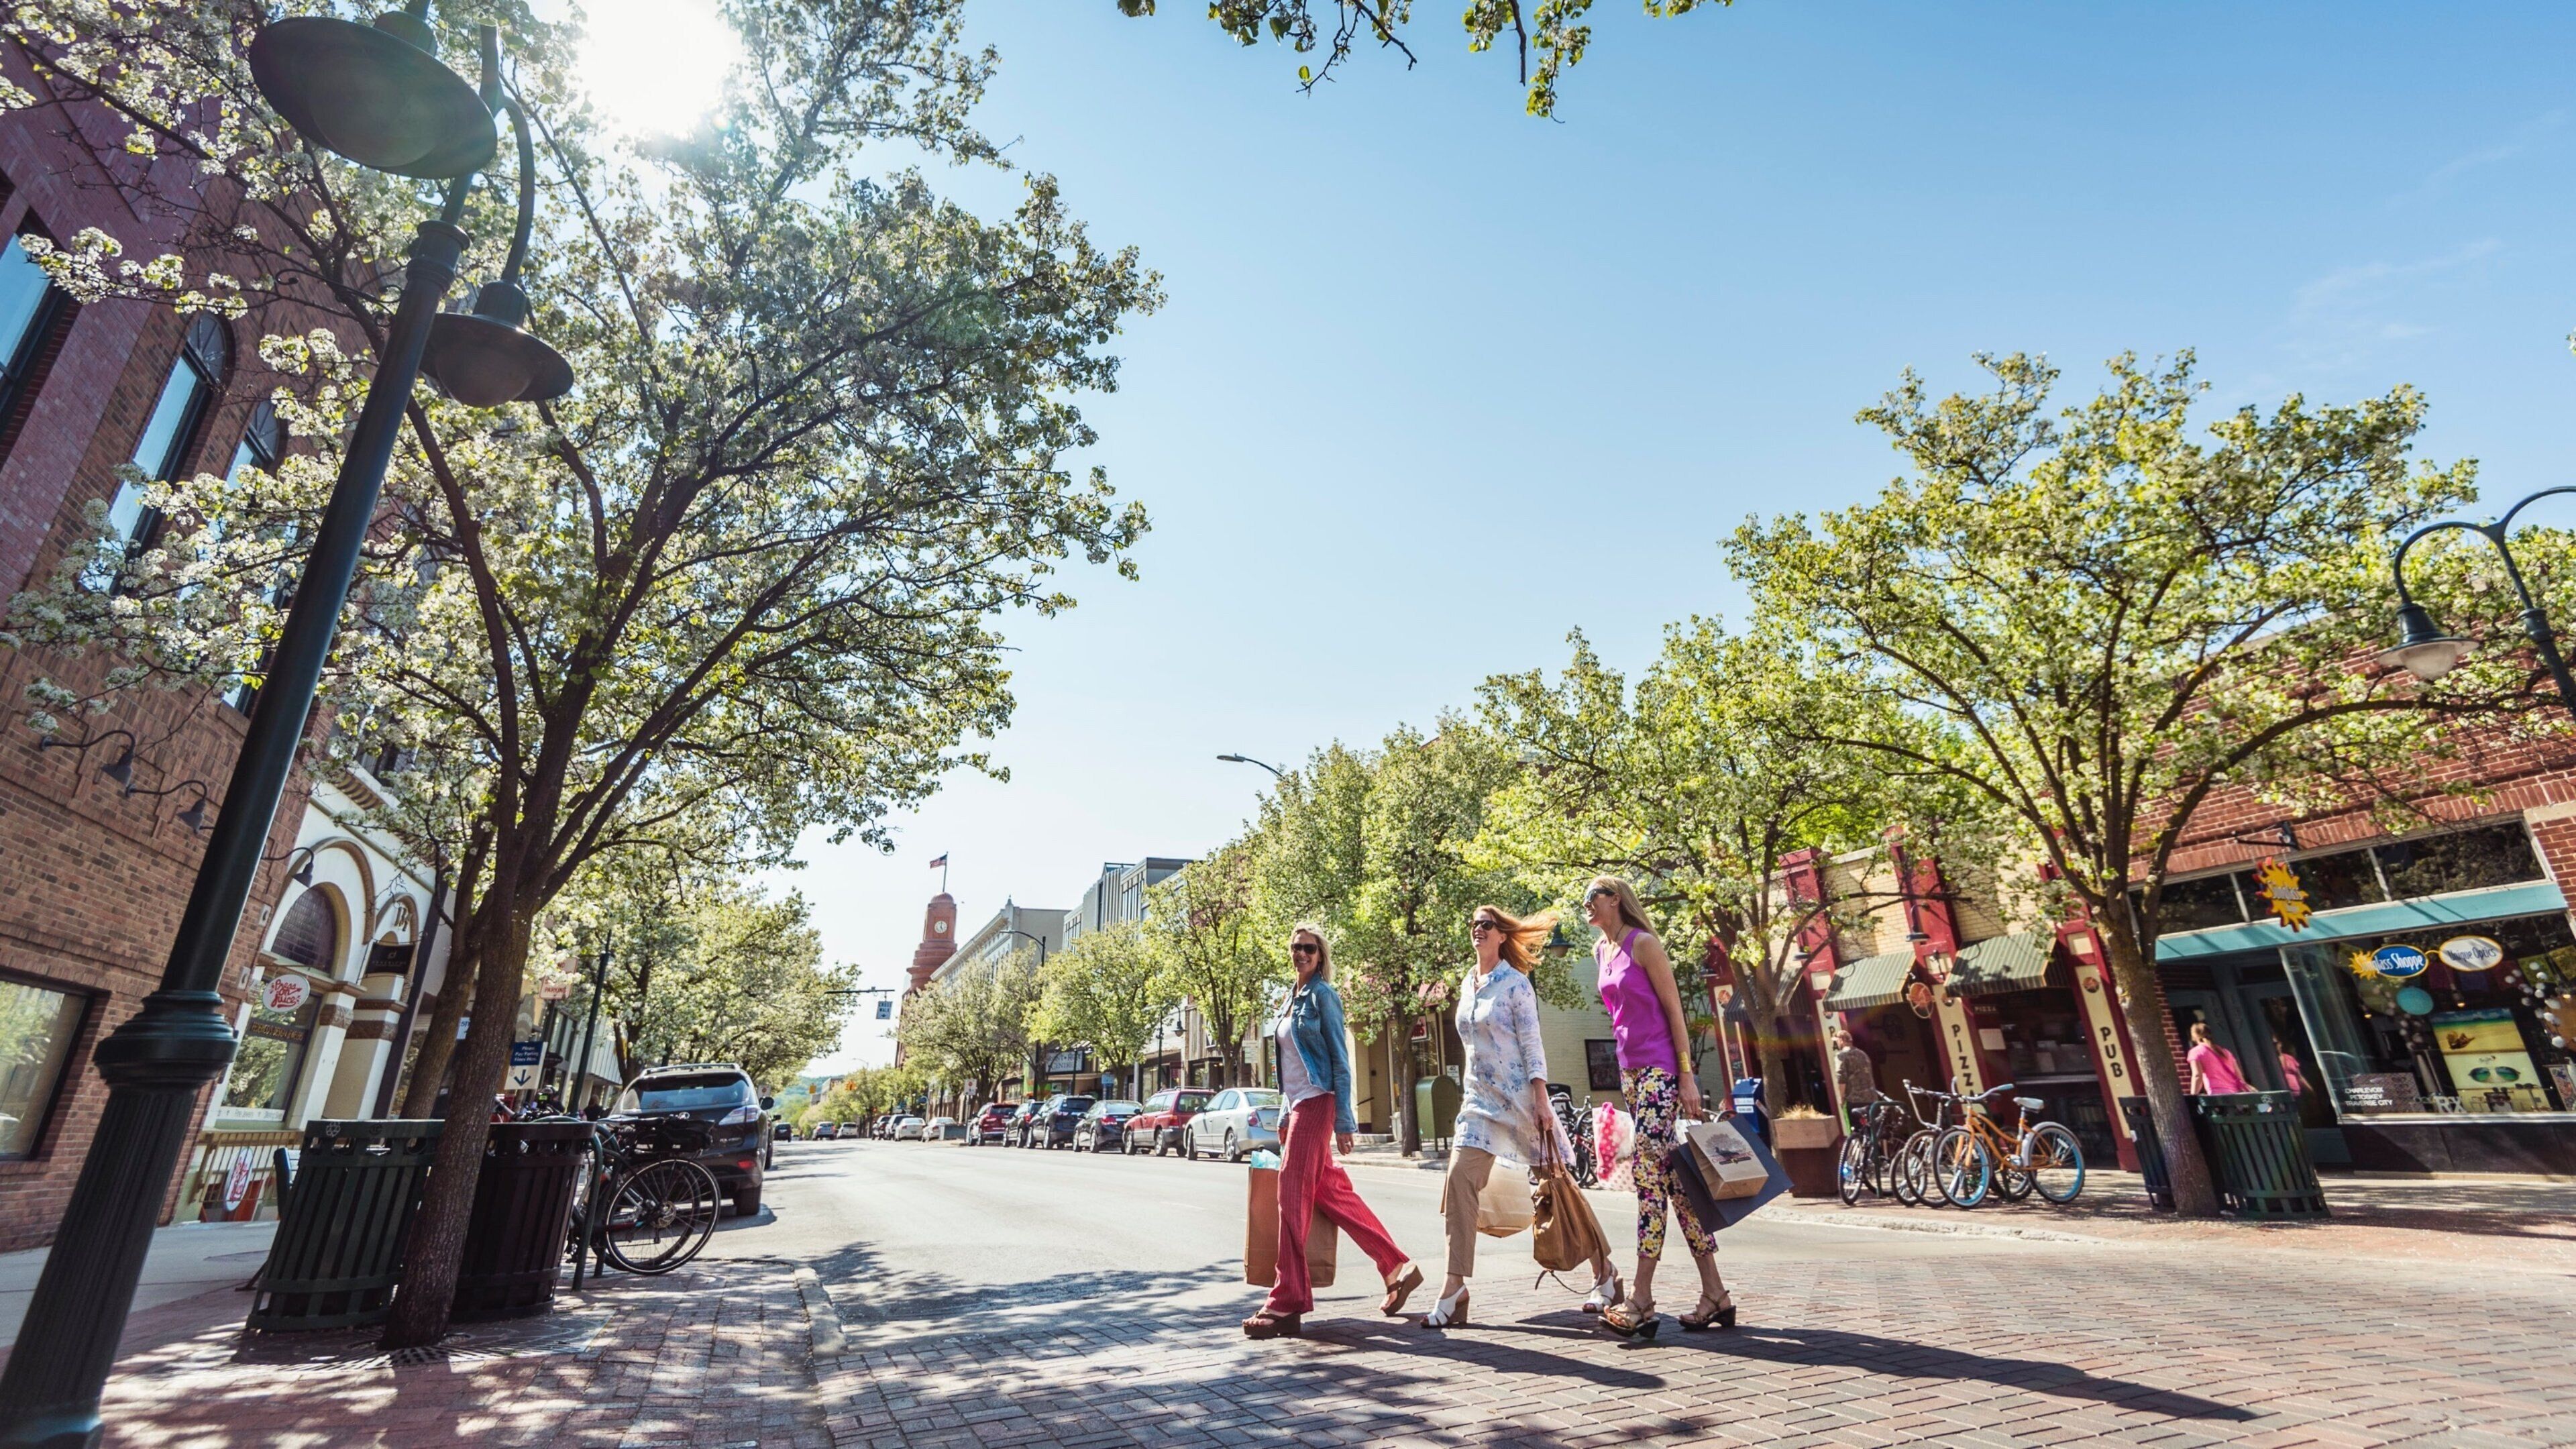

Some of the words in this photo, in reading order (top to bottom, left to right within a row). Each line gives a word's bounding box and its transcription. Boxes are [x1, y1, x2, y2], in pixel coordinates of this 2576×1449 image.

[2391, 953, 2424, 971] Shoppe
[2449, 950, 2473, 962] Unique
[2472, 946, 2498, 960] Optics
[275, 979, 297, 991] Press
[2100, 1026, 2123, 1077] PUB
[2345, 1086, 2384, 1094] CHARLEVOIX
